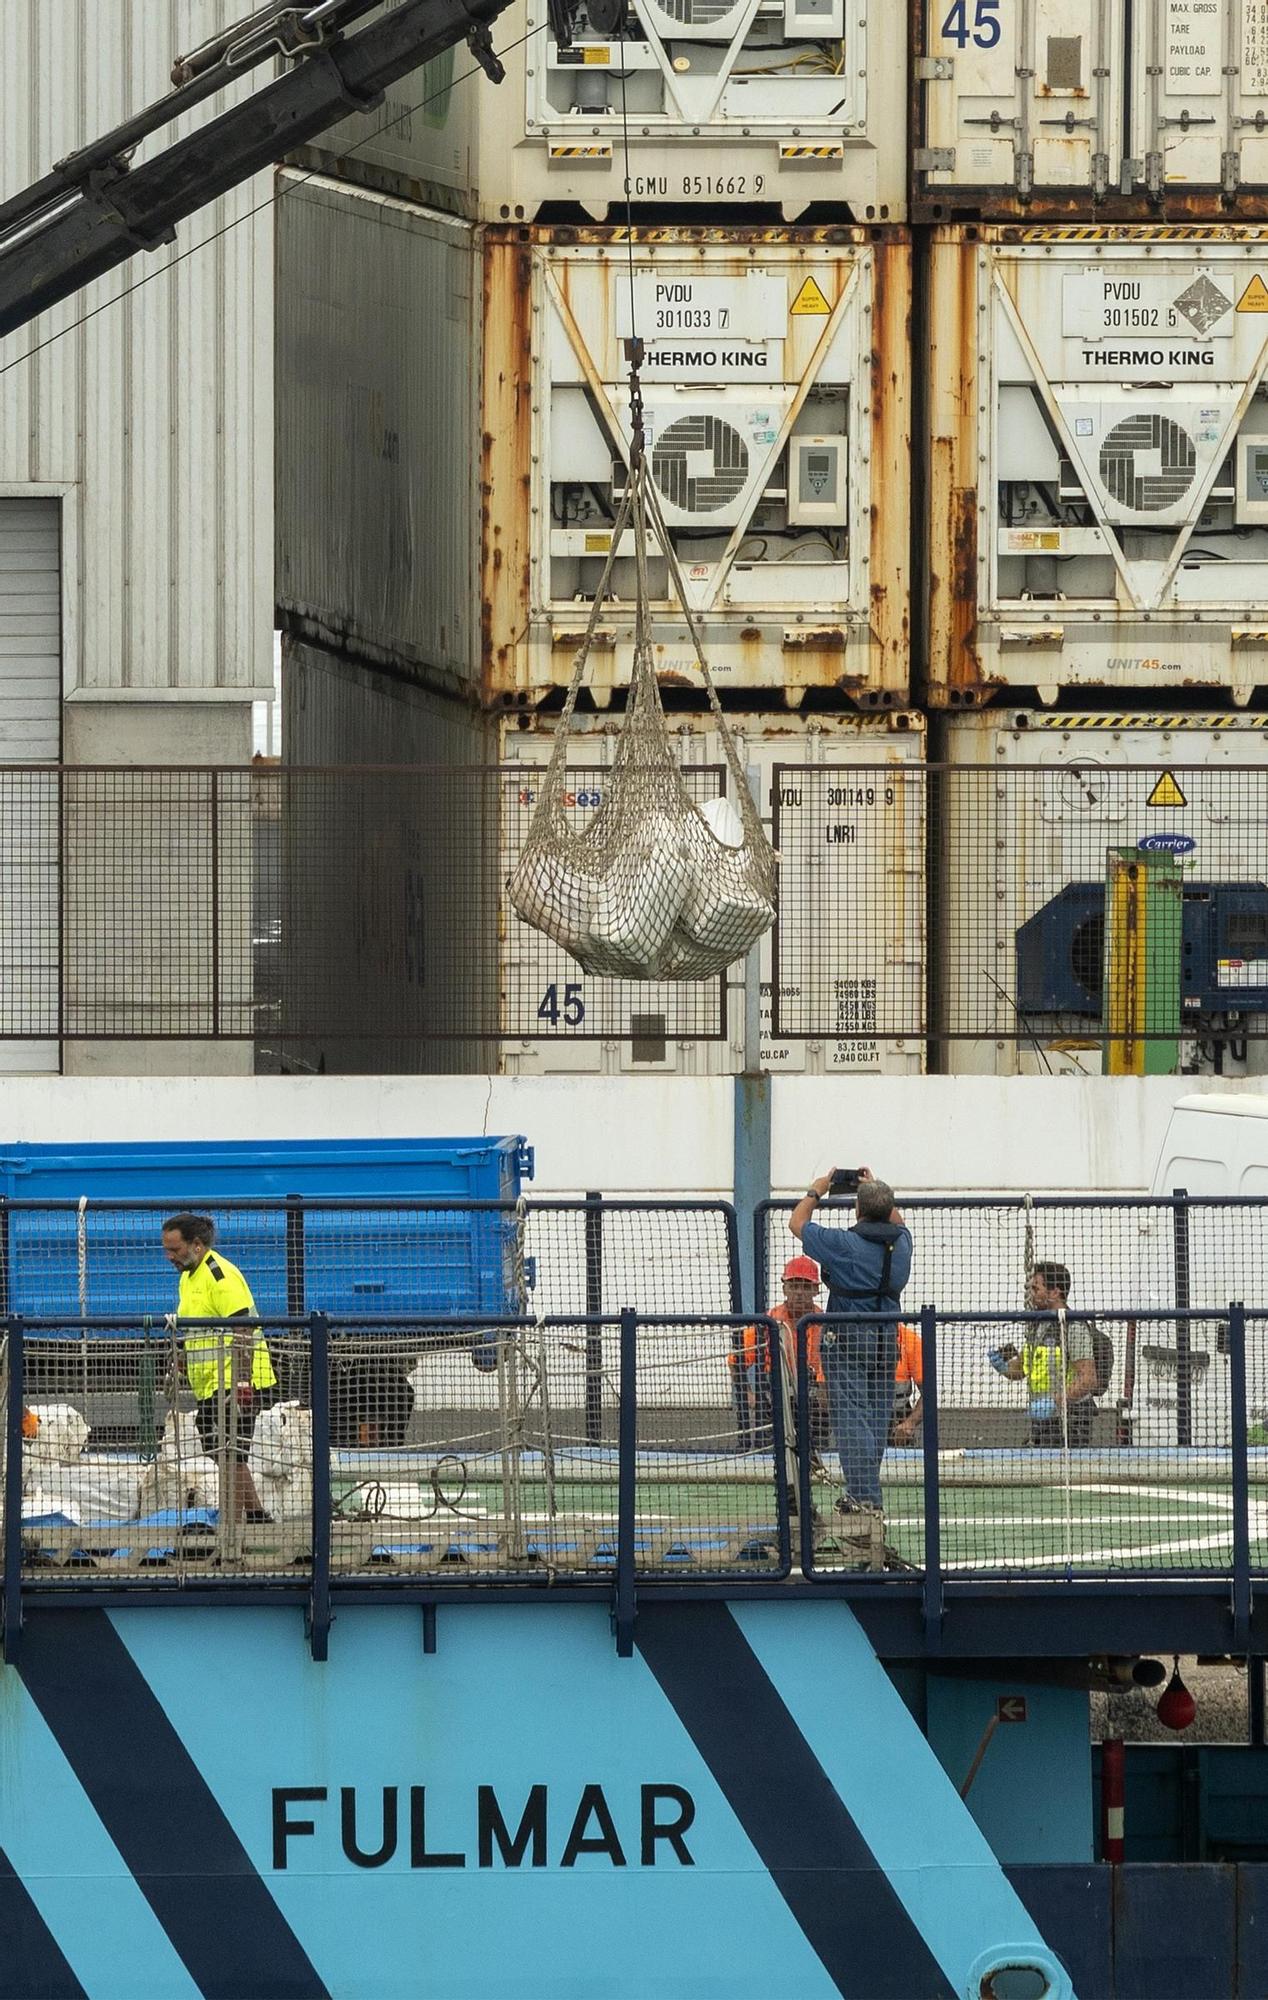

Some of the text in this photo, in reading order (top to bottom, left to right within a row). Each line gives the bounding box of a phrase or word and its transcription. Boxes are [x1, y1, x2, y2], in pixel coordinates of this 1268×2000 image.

[1193, 3, 1217, 13] GROSS
[941, 0, 1001, 48] 45
[1171, 24, 1190, 34] TARE
[1170, 45, 1206, 55] PAYLOAD
[1169, 66, 1191, 76] CUBIC
[624, 175, 764, 195] CGMU 851662 9
[656, 284, 692, 302] PVDU
[1103, 282, 1140, 301] PVDU
[656, 310, 728, 328] 301033 7
[1103, 308, 1177, 327] 301502 5
[643, 351, 768, 366] HERMO KING
[1082, 350, 1214, 365] THERMO KING
[656, 659, 732, 672] UNIT4.com
[1106, 658, 1181, 671] UNIT45.com
[827, 787, 874, 806] 301149
[885, 787, 894, 806] 9
[826, 825, 855, 843] LNR1
[1146, 838, 1190, 850] Carrier
[861, 989, 876, 998] LBS
[537, 983, 586, 1026] 45
[861, 1010, 876, 1020] LBS
[857, 1041, 876, 1051] CU.M
[760, 1050, 790, 1060] CU.CAP
[857, 1052, 880, 1062] CU.FT
[271, 1783, 696, 1869] FULMAR
